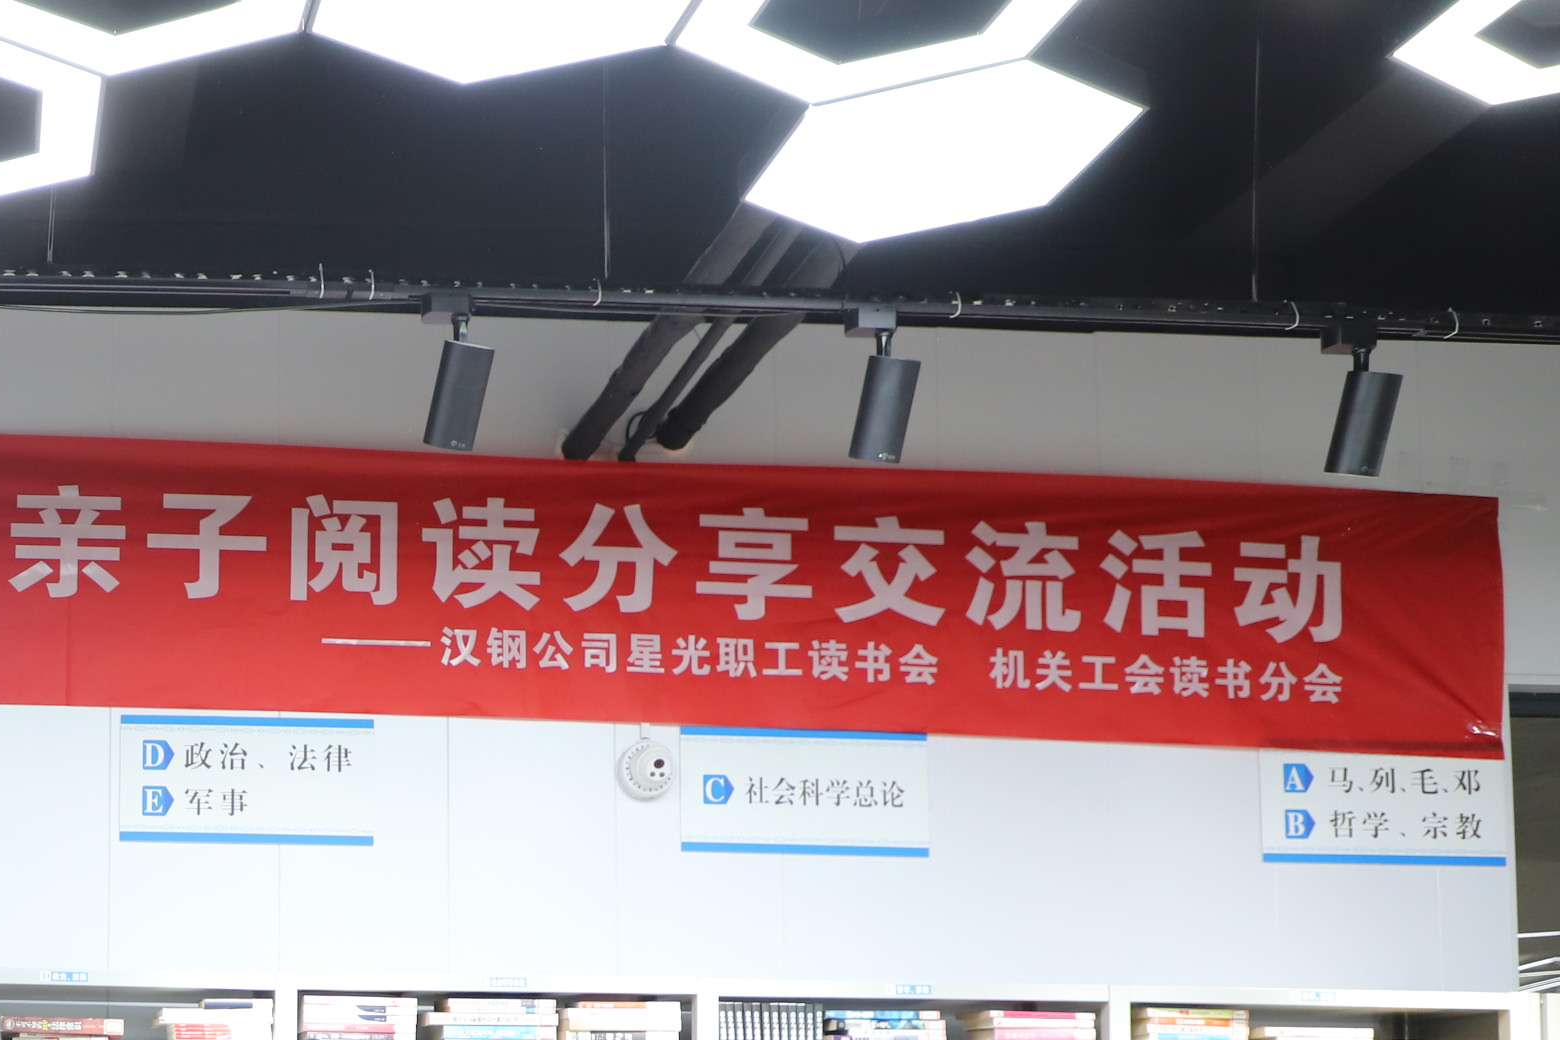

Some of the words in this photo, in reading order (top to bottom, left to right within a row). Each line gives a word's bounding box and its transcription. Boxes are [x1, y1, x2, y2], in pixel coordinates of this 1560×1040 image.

[8, 484, 1344, 644] 亲子阅读分享交流活动
[989, 648, 1344, 705] 机关工会读书分会
[143, 742, 165, 769] D
[183, 742, 352, 772] 政治、法律
[704, 777, 724, 804] C
[745, 774, 905, 811] 社会科学总论
[1285, 766, 1305, 791] A
[1327, 766, 1482, 797] 马、列、毛、邓
[143, 788, 165, 815] E
[184, 788, 248, 816] 军事
[1287, 811, 1306, 837] B
[1328, 809, 1484, 842] 哲学、宗教
